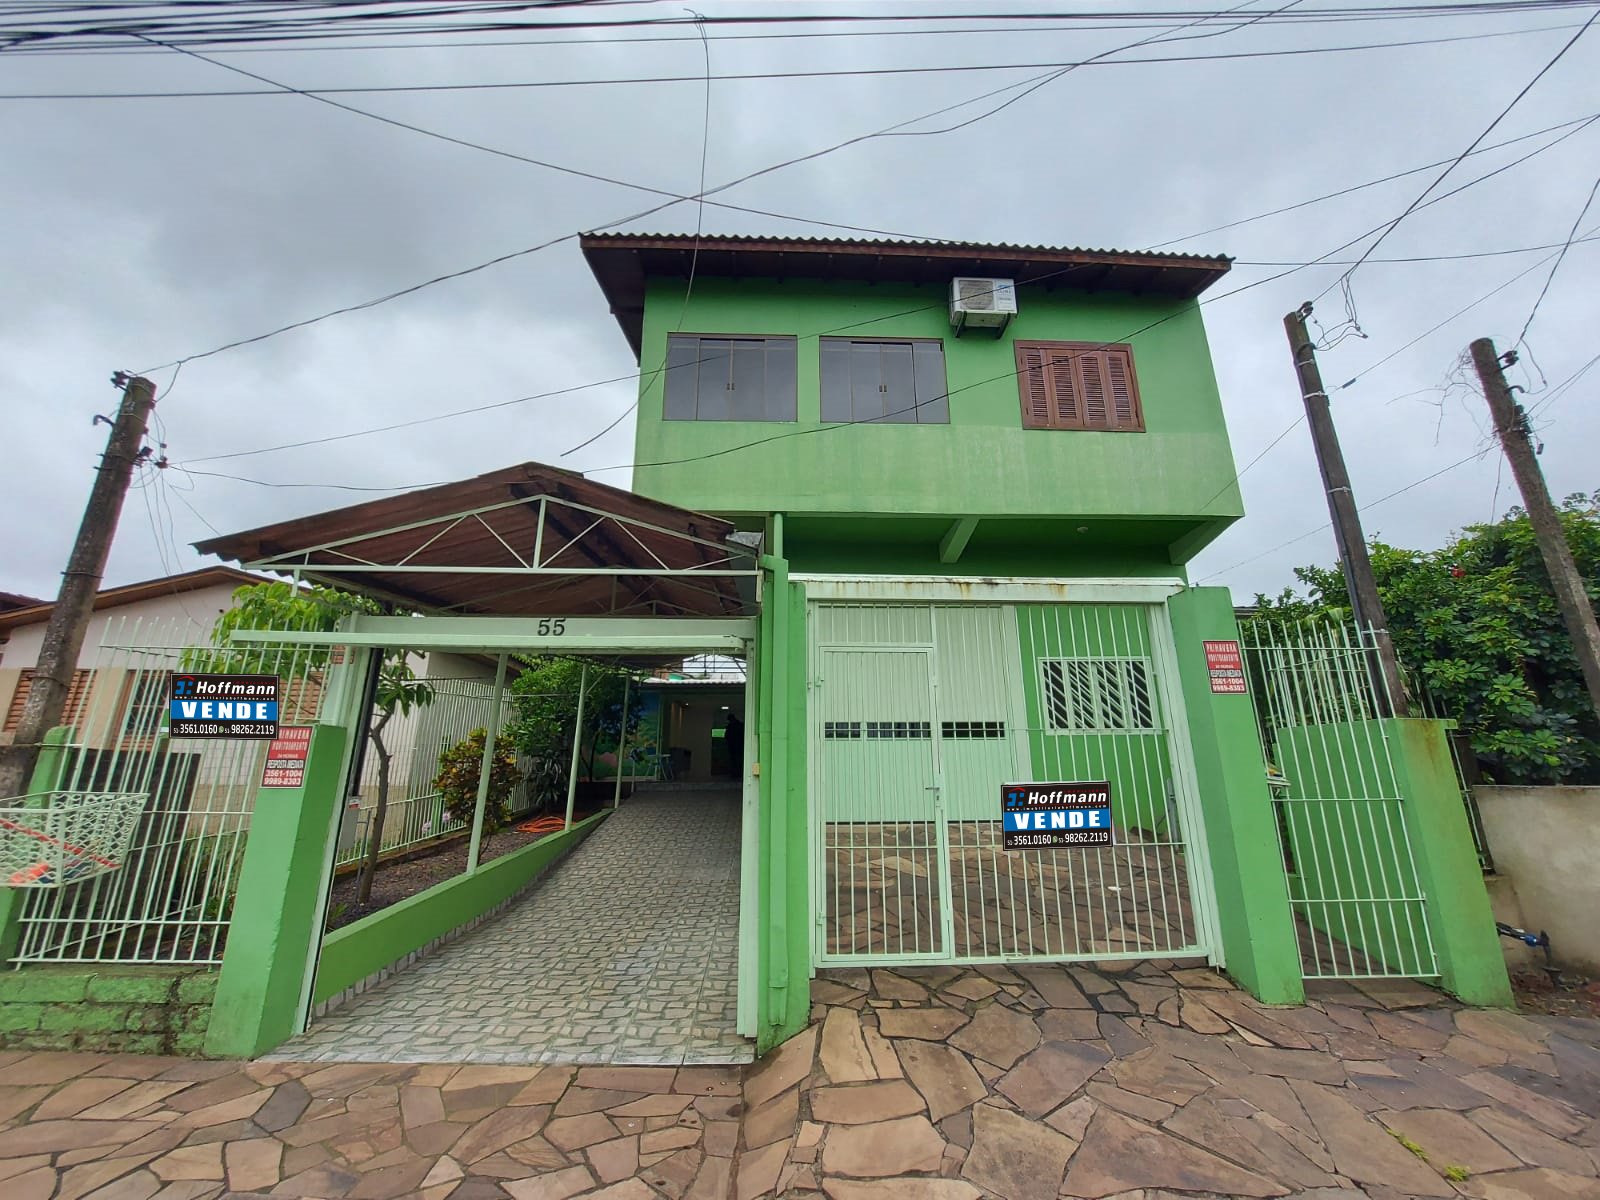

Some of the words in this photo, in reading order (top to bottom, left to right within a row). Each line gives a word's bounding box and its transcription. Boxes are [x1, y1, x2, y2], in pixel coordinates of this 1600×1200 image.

[537, 617, 566, 636] 55
[196, 681, 275, 695] Hoffmann
[181, 701, 268, 720] VENDE
[264, 769, 304, 777] 3561-1004
[1028, 791, 1107, 805] Hoffmann
[1014, 810, 1101, 830] VENDE
